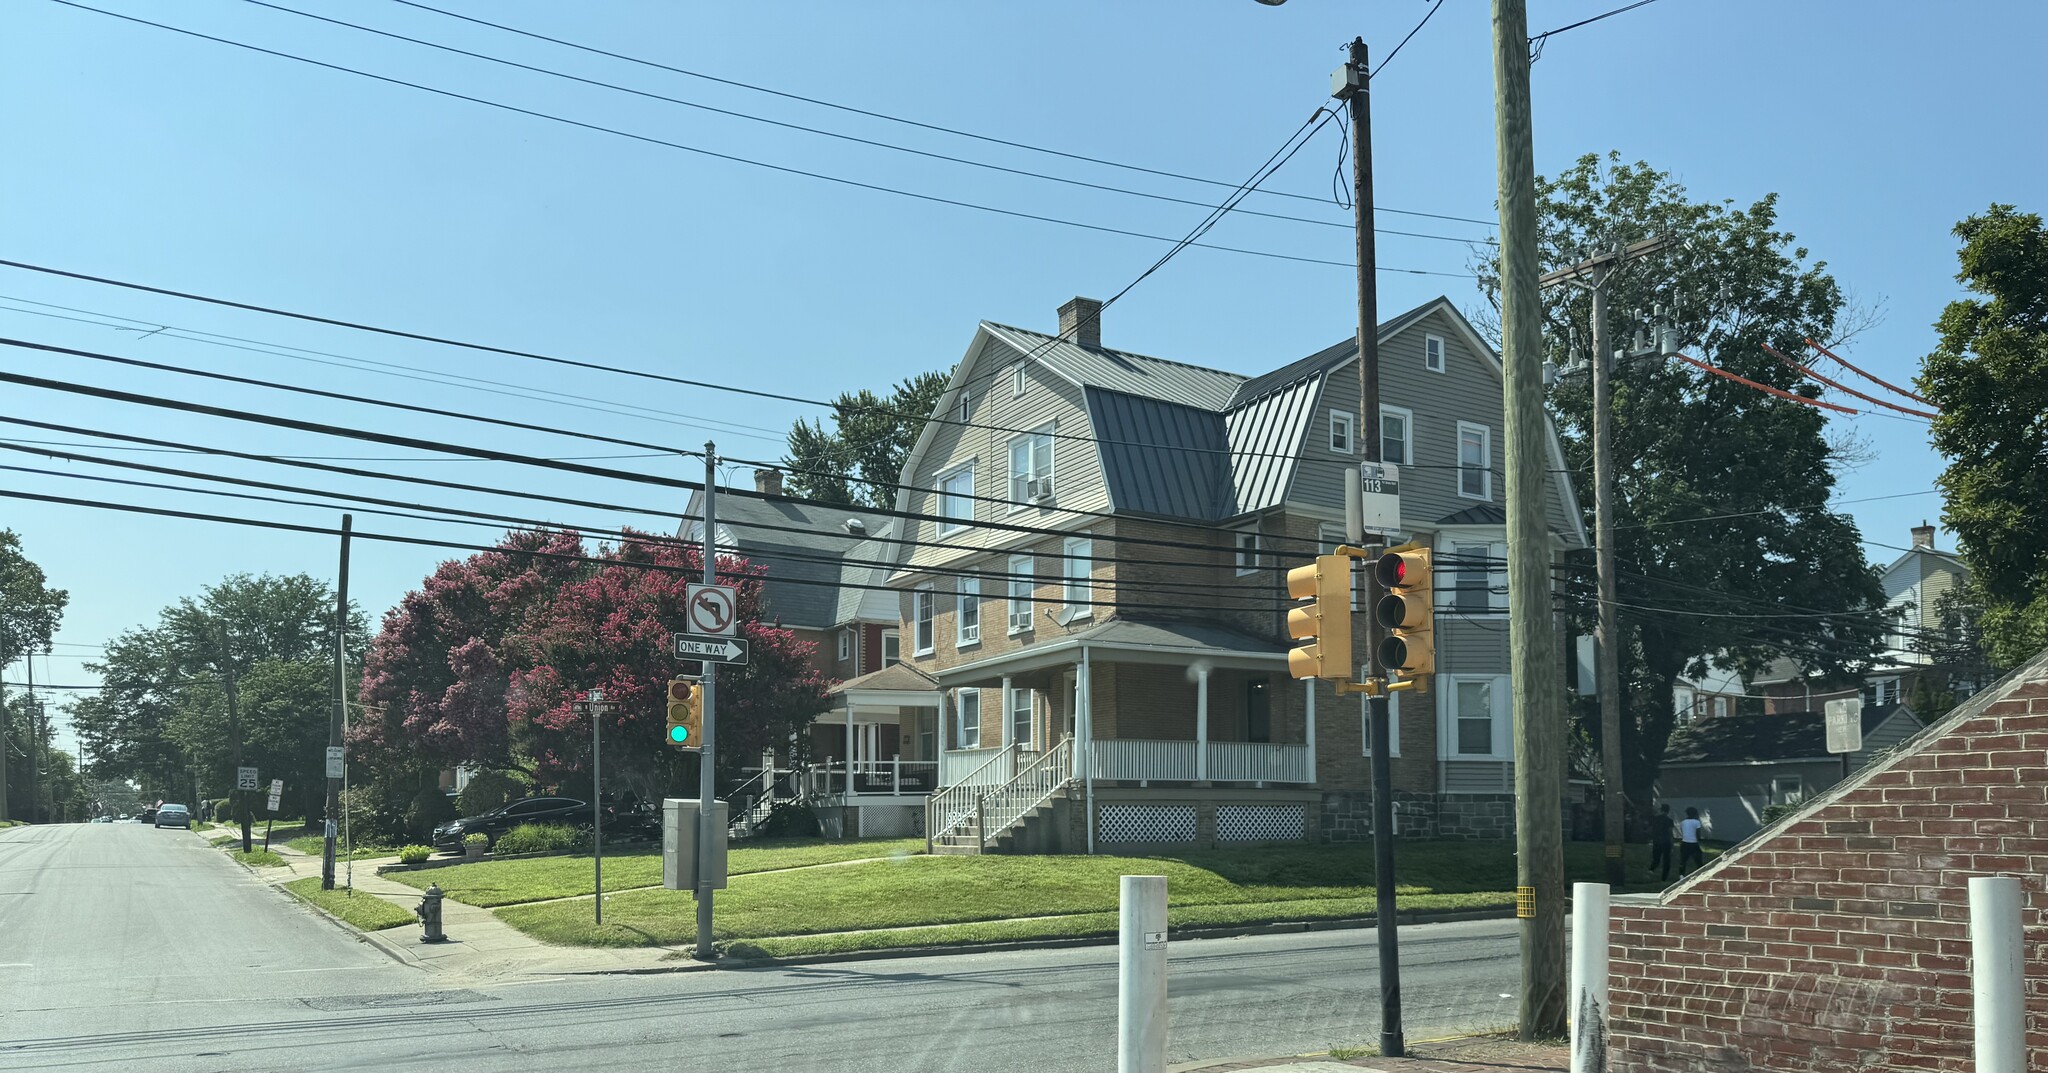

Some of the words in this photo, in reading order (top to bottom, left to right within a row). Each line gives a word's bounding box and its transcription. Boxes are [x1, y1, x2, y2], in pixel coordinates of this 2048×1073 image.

[1364, 478, 1381, 493] 113
[680, 641, 701, 653] ONE
[705, 643, 727, 655] WAY
[589, 702, 608, 712] Union
[240, 778, 256, 788] 25
